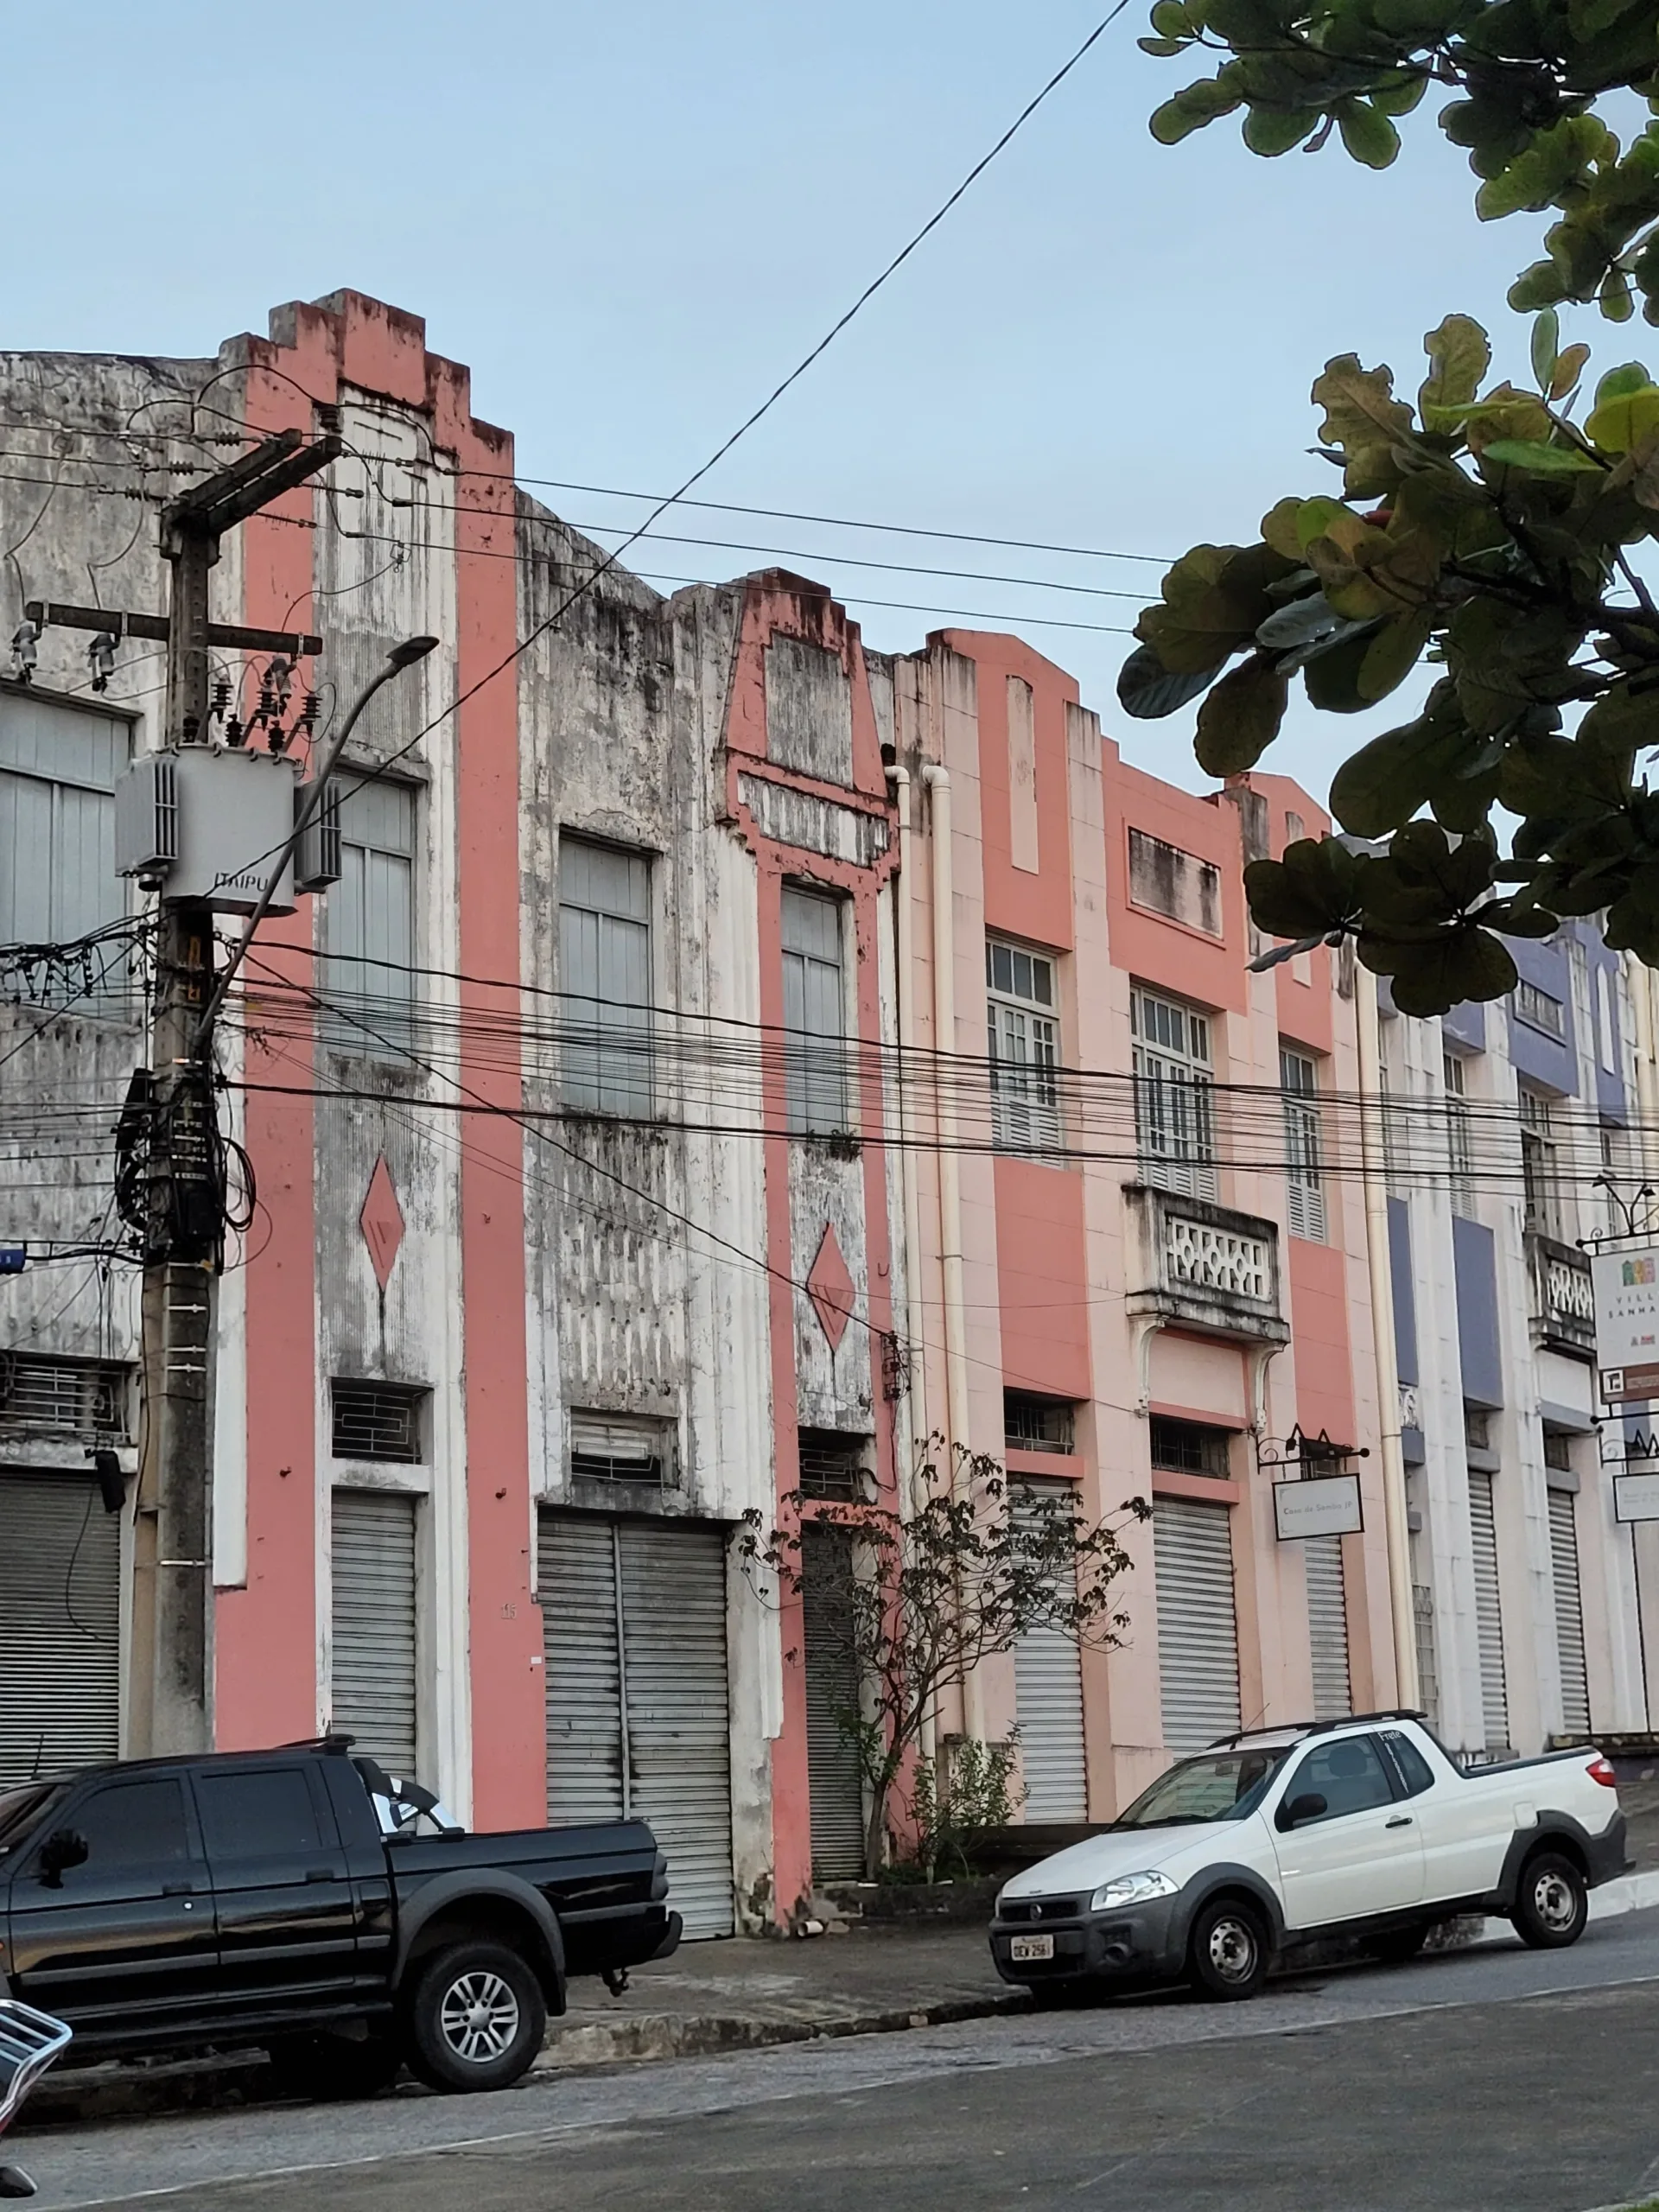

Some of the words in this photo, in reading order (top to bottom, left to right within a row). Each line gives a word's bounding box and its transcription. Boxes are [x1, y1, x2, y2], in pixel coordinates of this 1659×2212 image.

[214, 872, 269, 893] ITAIPU
[1608, 1306, 1656, 1319] SANHA
[1305, 1504, 1313, 1513] de
[1377, 1731, 1402, 1742] Frete
